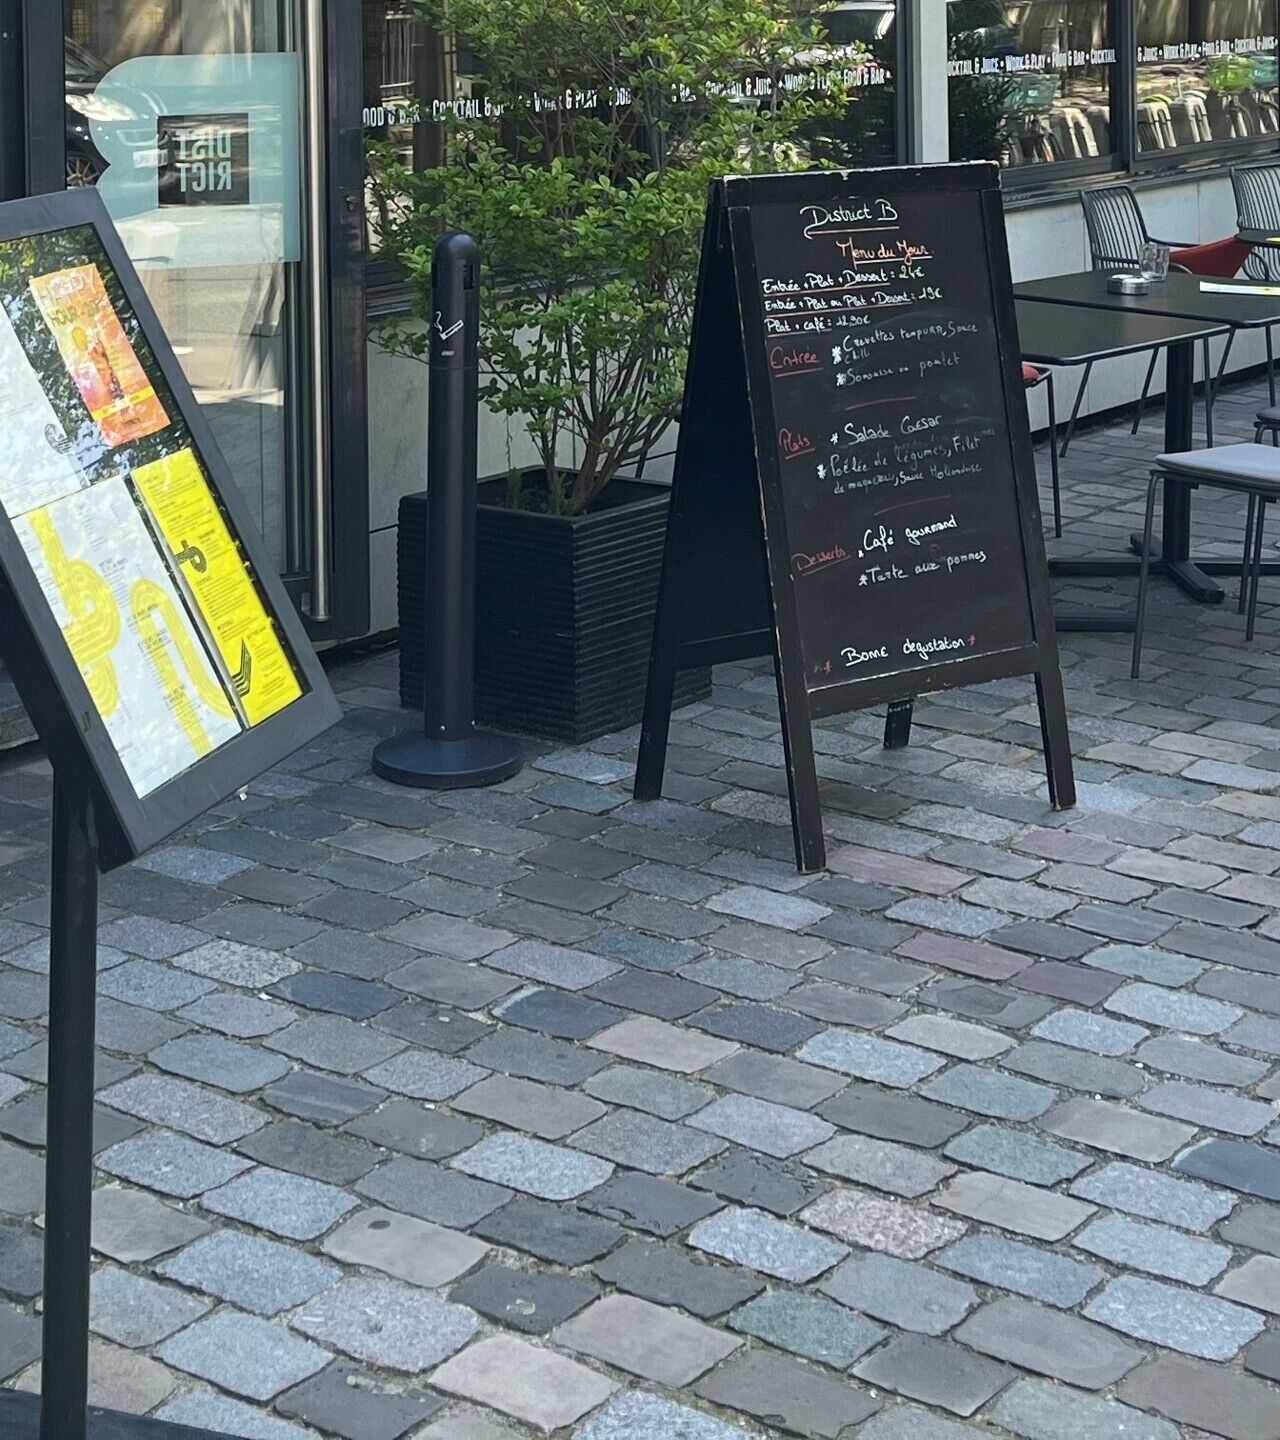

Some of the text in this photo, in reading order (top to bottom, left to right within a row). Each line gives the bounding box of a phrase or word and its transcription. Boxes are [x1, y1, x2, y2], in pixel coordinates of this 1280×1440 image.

[754, 76, 772, 96] JUIC
[362, 106, 385, 127] OOD
[800, 199, 898, 239] District B
[836, 237, 875, 270] Menu
[877, 244, 896, 258] du
[761, 278, 800, 293] Entrée
[805, 273, 834, 288] Plat
[804, 296, 828, 310] Plat
[764, 318, 792, 333] Plat
[844, 422, 893, 446] Salade
[863, 525, 895, 553] Café
